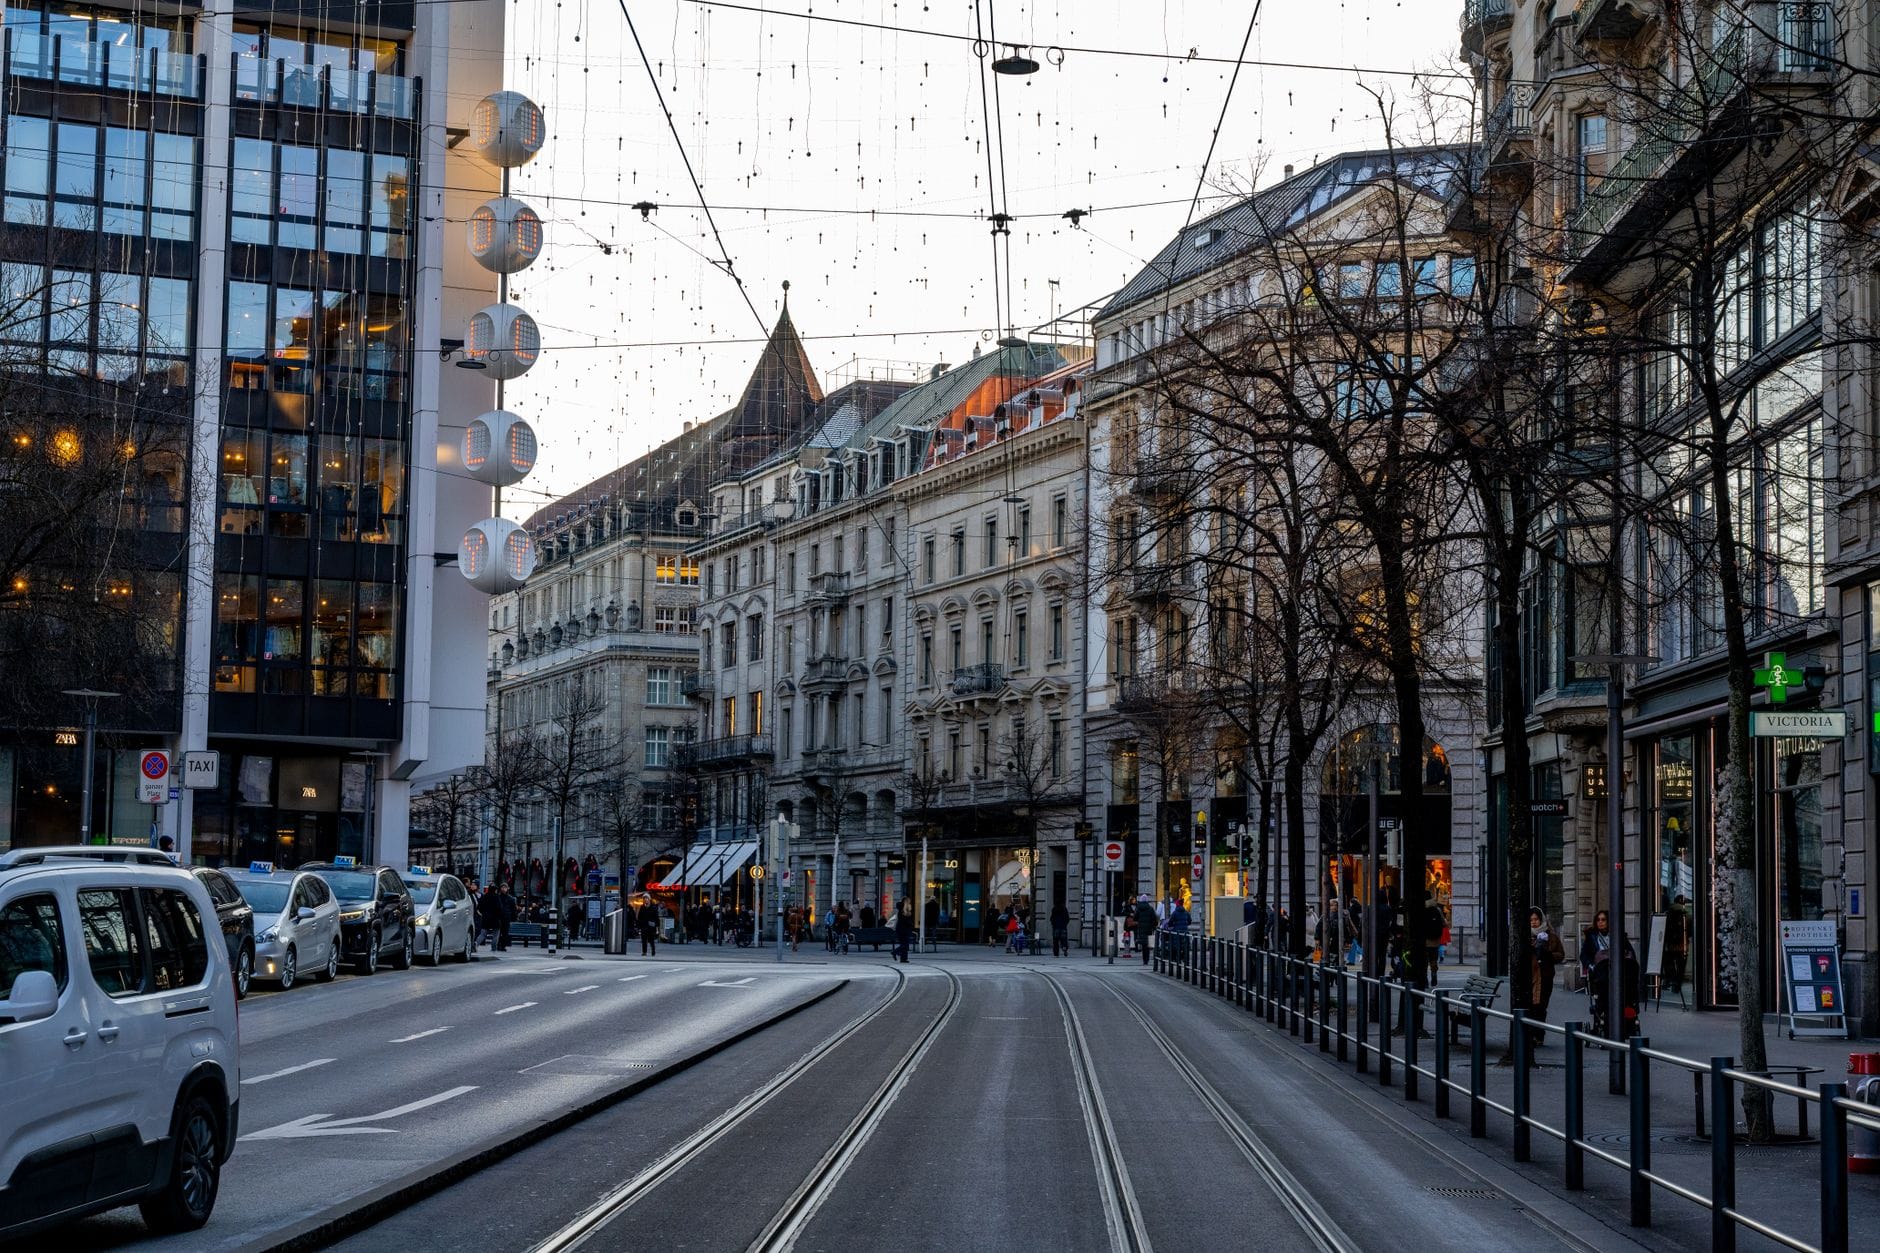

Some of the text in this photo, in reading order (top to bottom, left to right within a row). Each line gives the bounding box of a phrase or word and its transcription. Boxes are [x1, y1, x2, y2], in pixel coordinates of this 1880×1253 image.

[1767, 716, 1833, 727] VICTORIA
[55, 733, 77, 745] ZARA
[188, 760, 214, 772] TAXI
[1531, 803, 1558, 812] watch
[253, 862, 272, 871] TAXI
